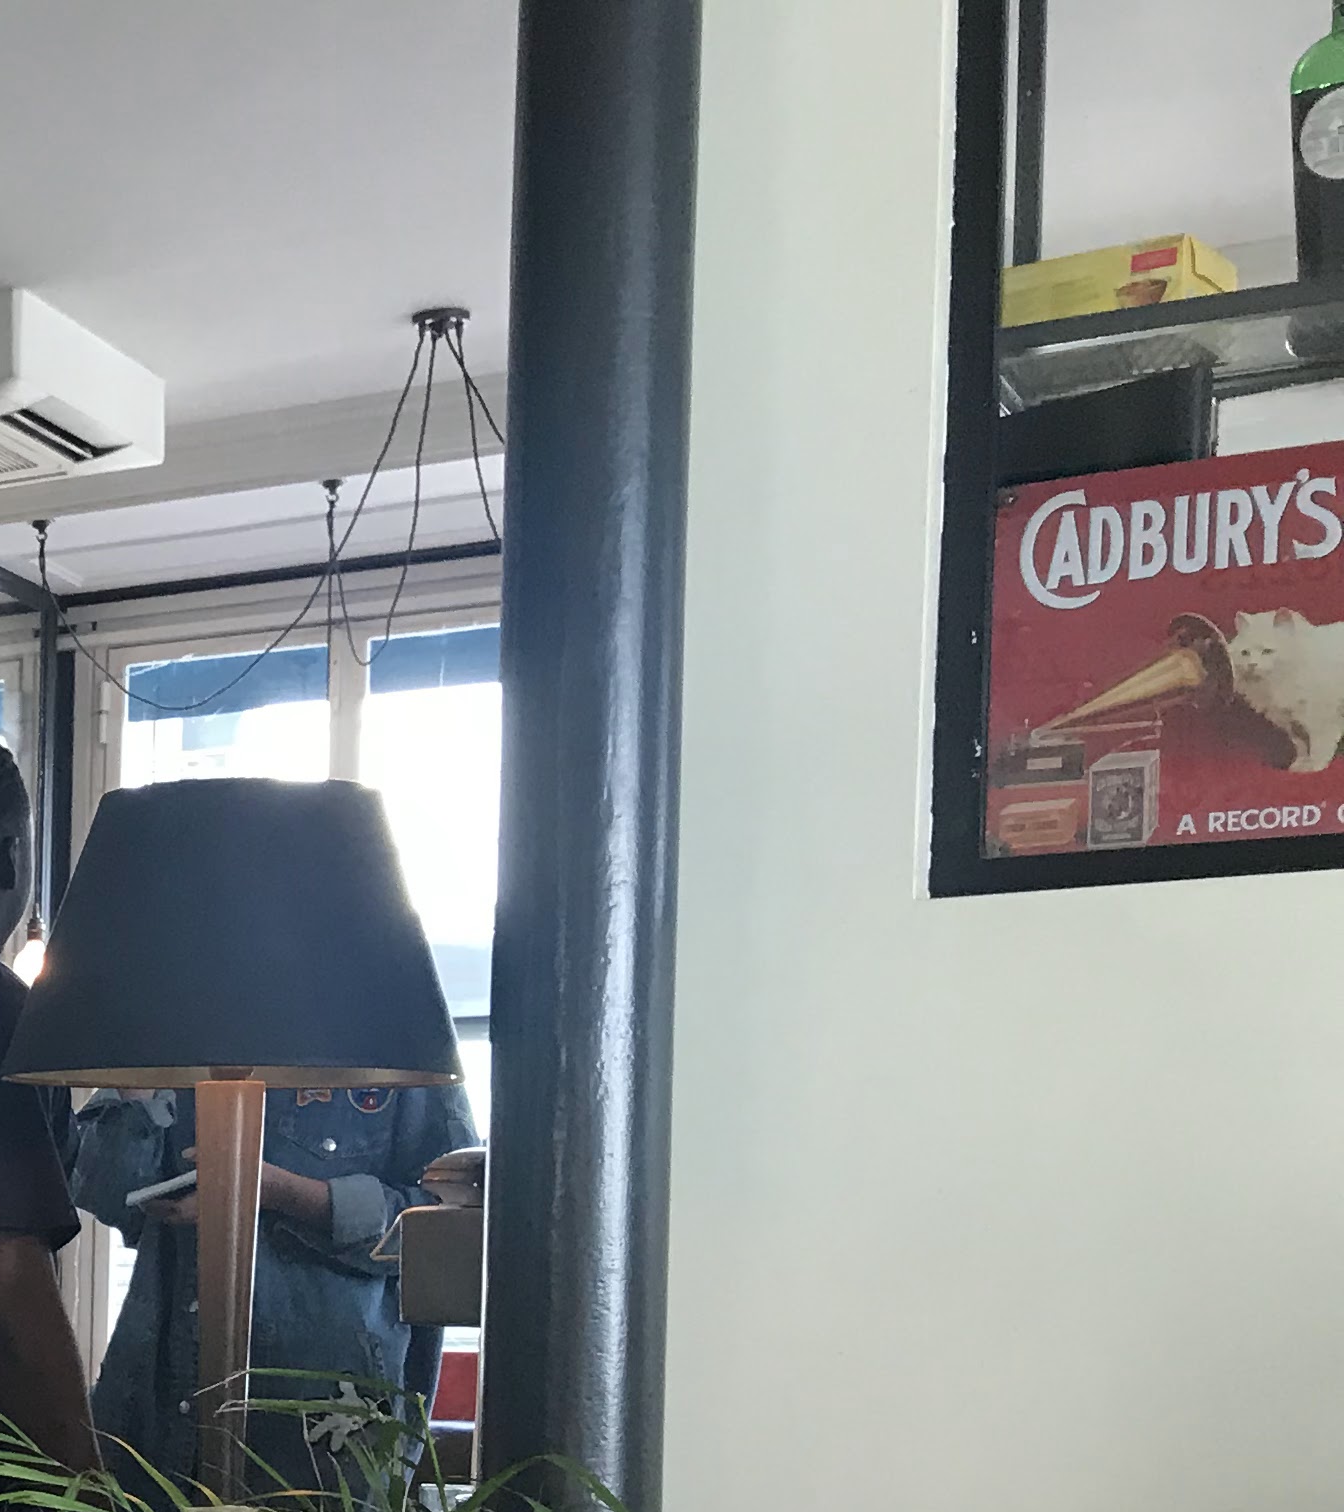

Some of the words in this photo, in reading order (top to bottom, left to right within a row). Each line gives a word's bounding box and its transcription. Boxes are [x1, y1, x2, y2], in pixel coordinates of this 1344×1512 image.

[1019, 468, 1342, 610] CADBURY'S
[1175, 813, 1197, 836] A
[1208, 804, 1321, 833] RECORD
